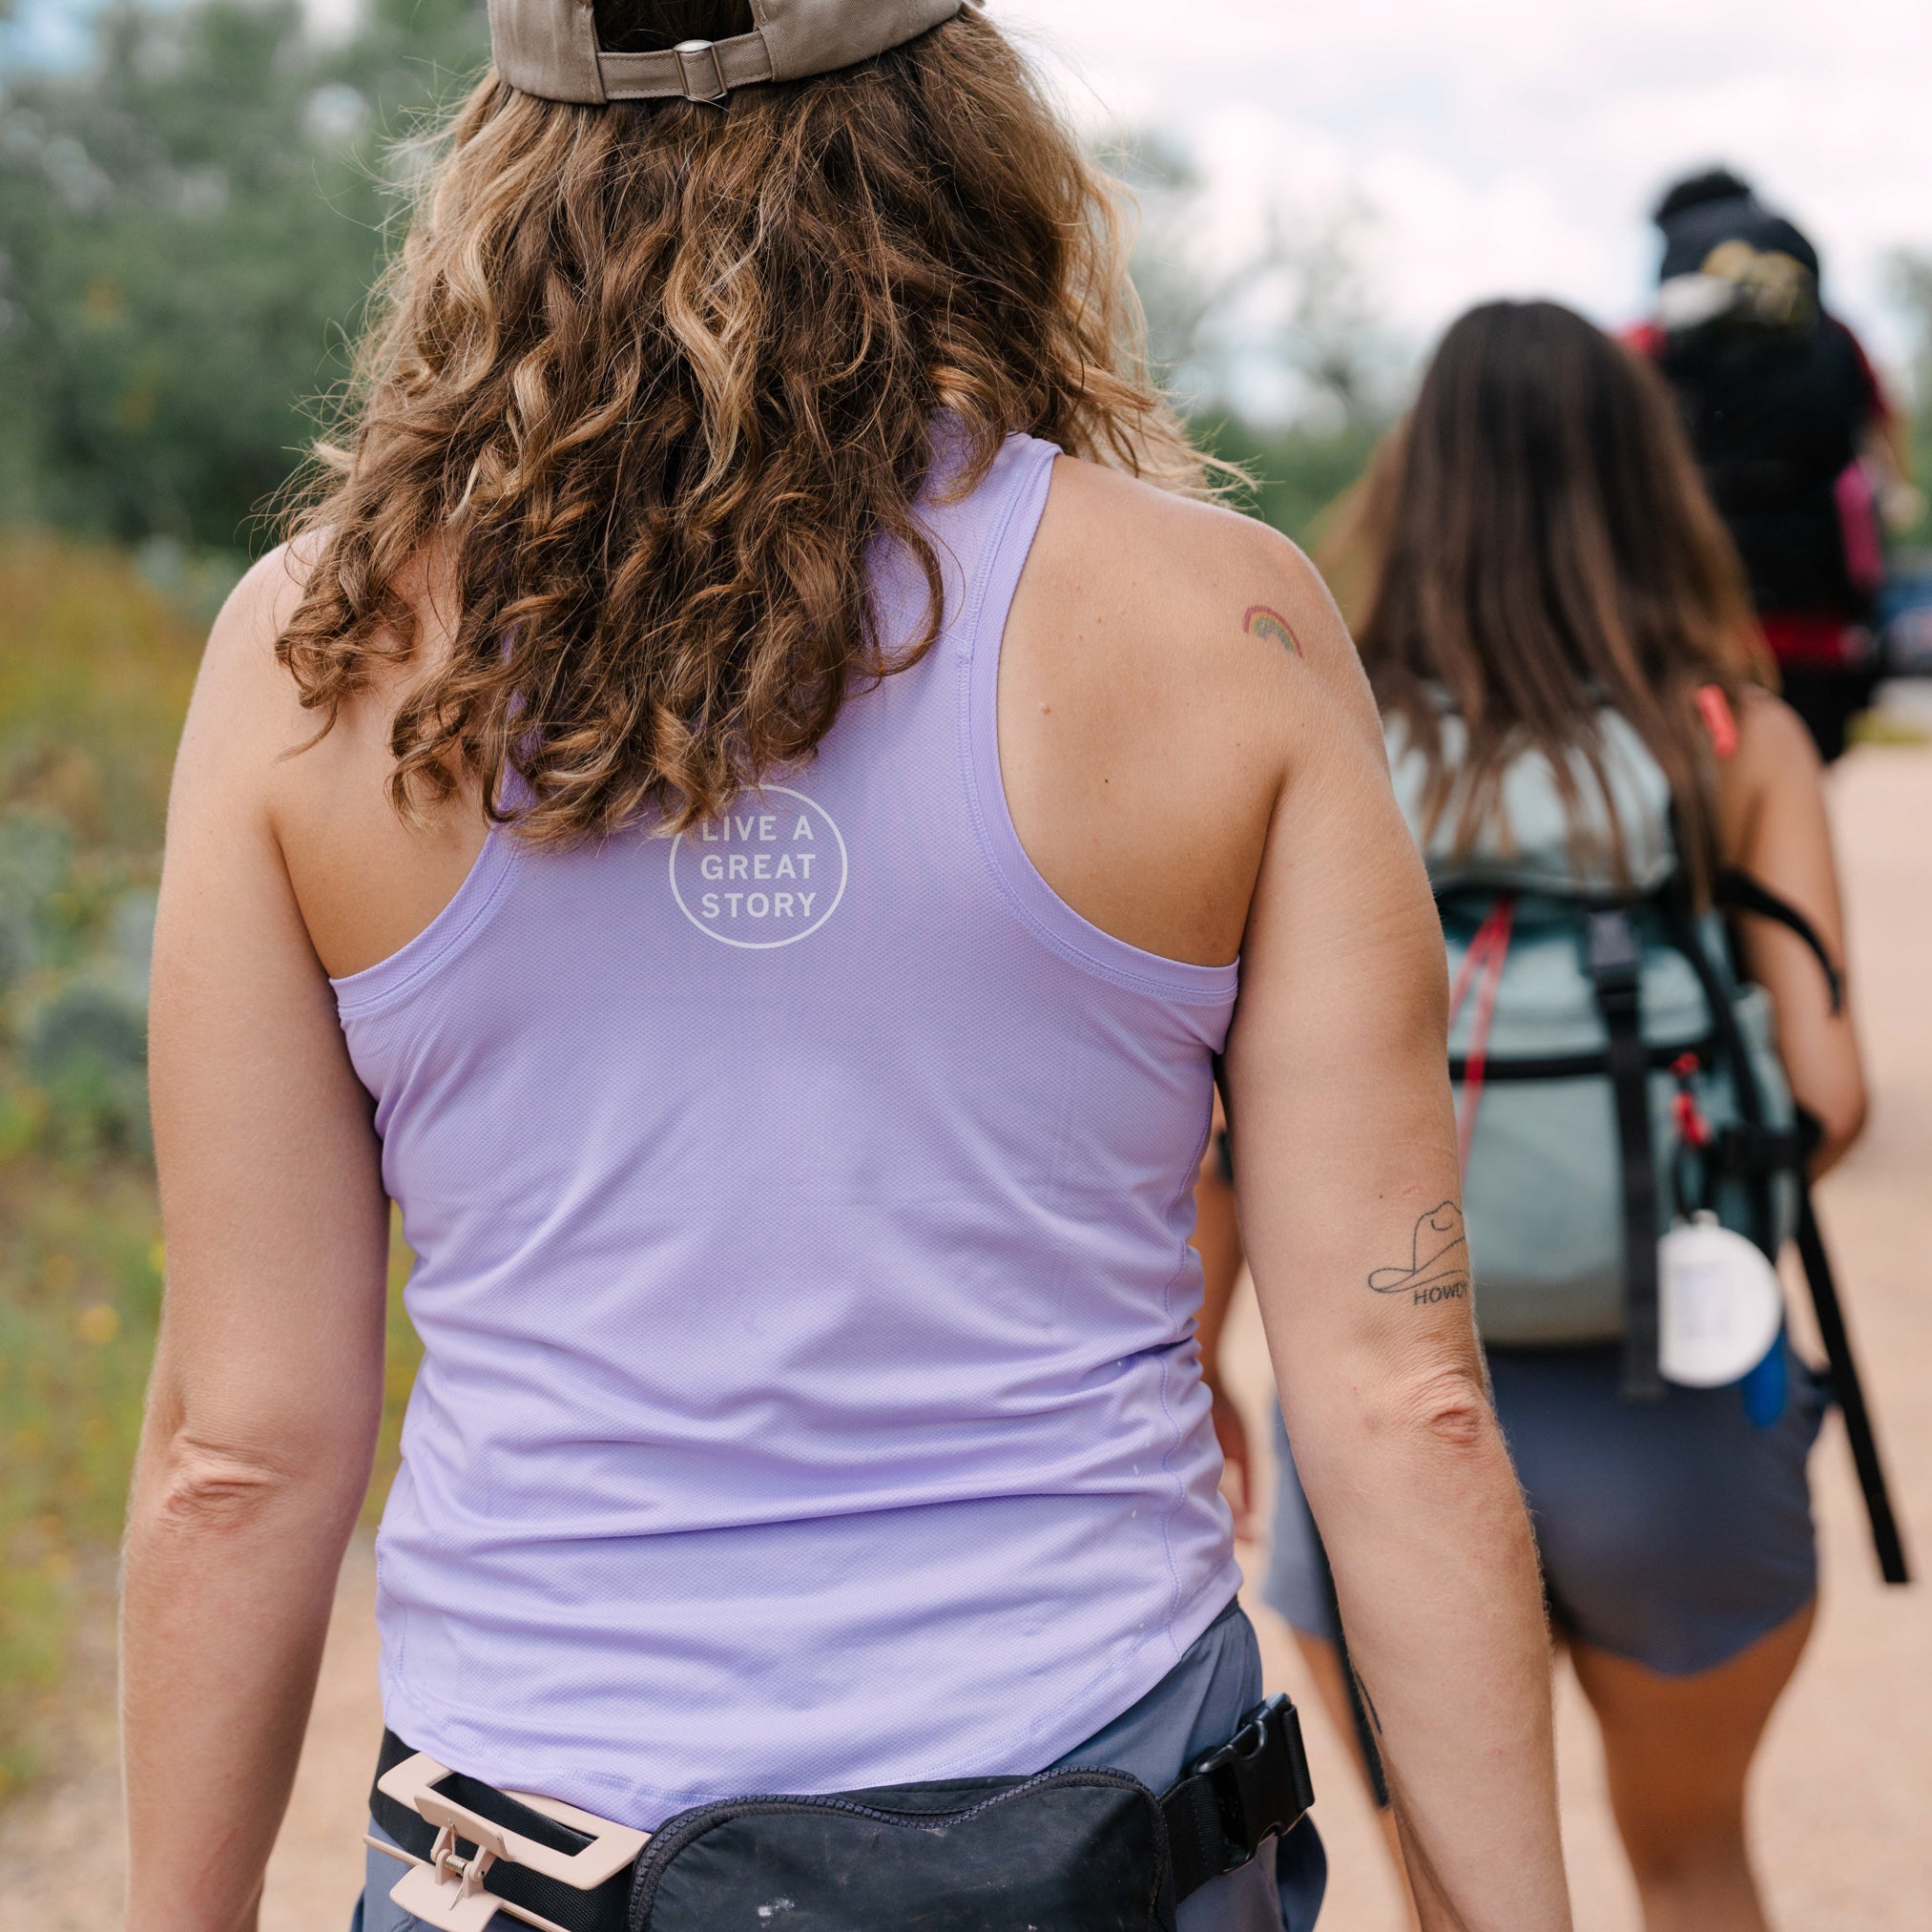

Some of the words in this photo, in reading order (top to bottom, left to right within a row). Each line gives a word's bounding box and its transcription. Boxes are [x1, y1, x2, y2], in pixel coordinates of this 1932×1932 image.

[702, 816, 777, 841] LIVE
[793, 815, 814, 840] A
[700, 854, 816, 880] GREAT
[701, 893, 817, 919] STORY
